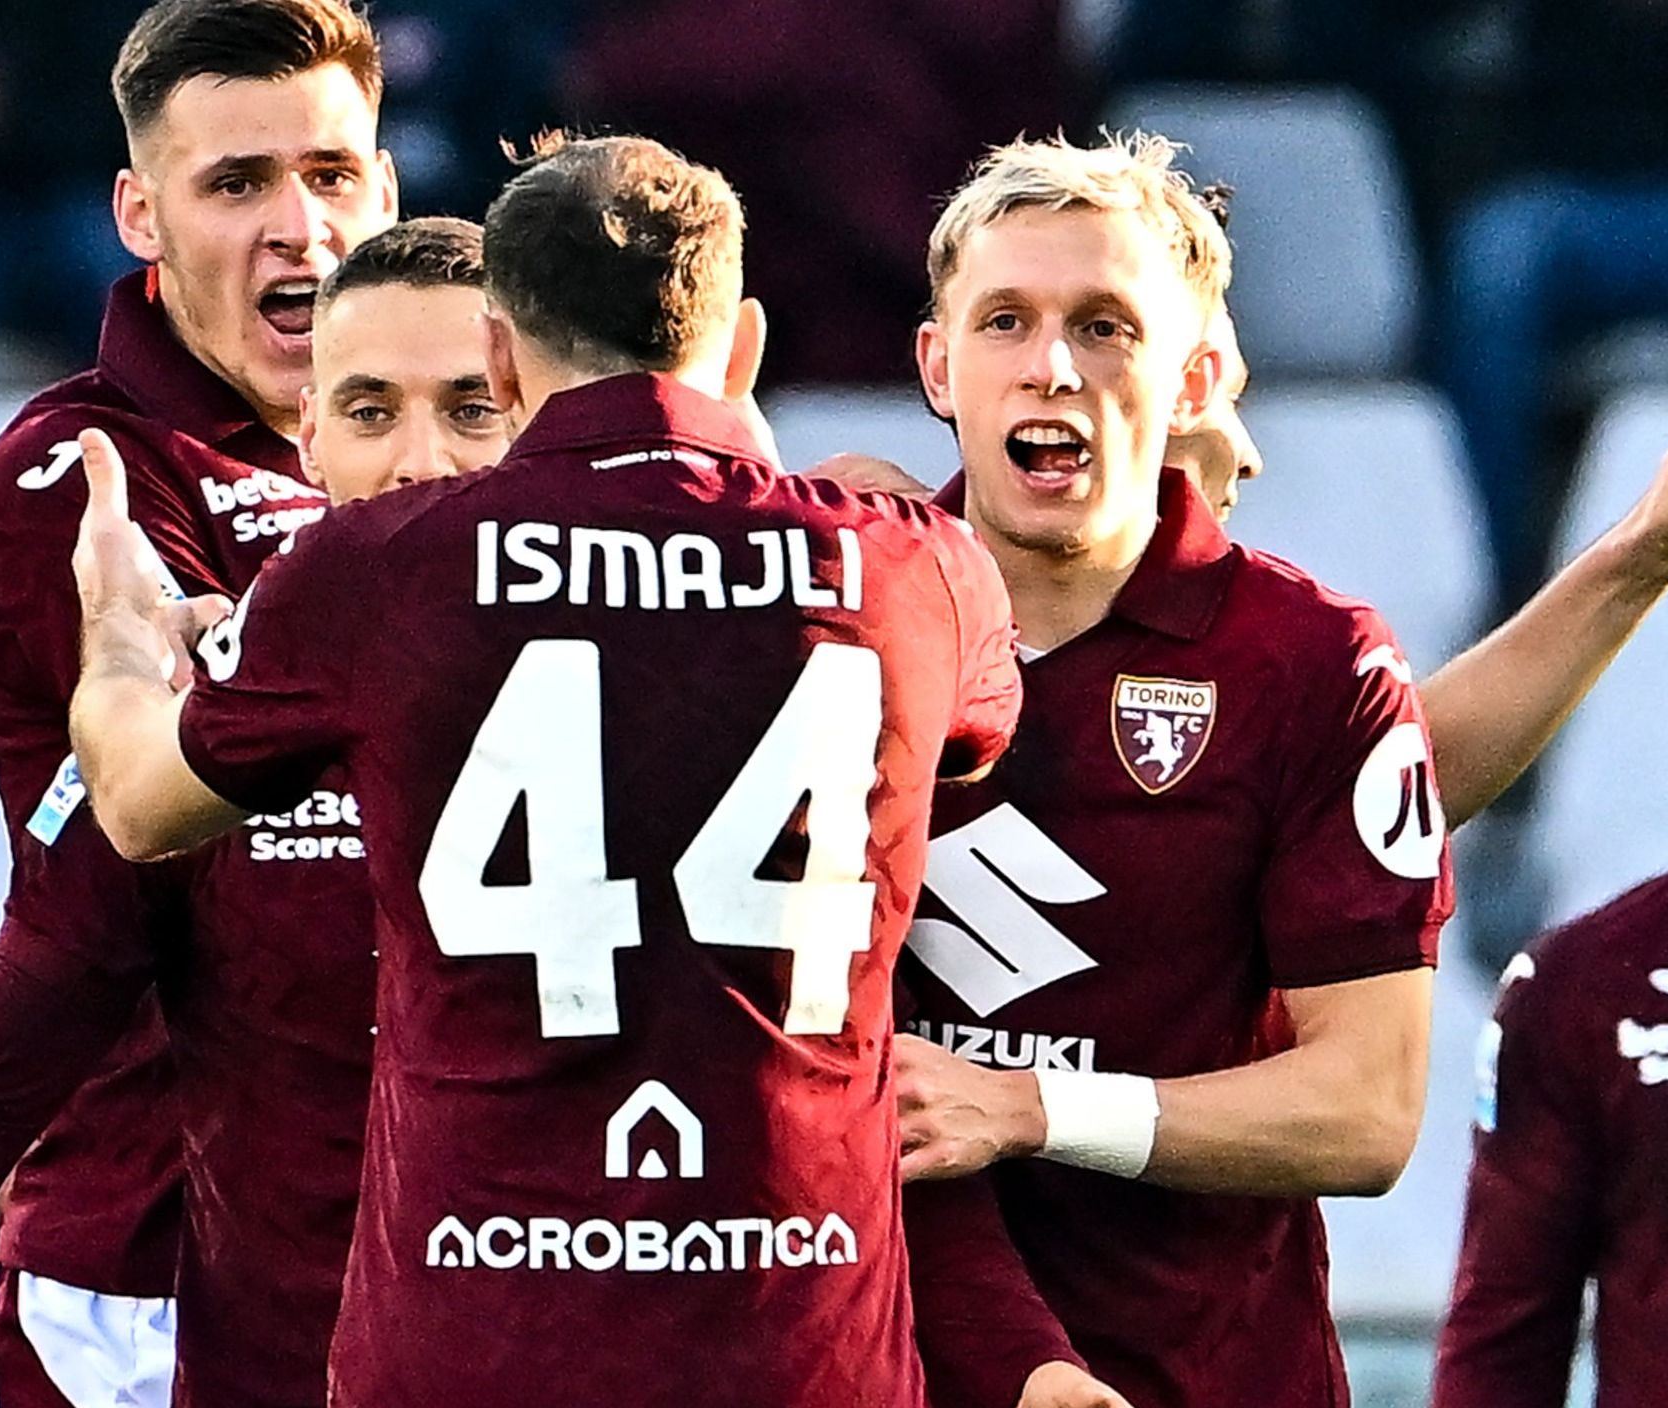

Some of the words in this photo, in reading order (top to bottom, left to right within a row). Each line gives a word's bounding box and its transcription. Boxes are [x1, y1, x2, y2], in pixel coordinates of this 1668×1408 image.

[476, 520, 863, 612] ISMAJLI
[1126, 686, 1206, 708] TORINO
[1173, 715, 1203, 734] FC
[250, 832, 367, 861] Score
[419, 639, 882, 1039] 44
[906, 1019, 1096, 1073] UZUKI
[425, 1214, 859, 1272] ACROBATICA
